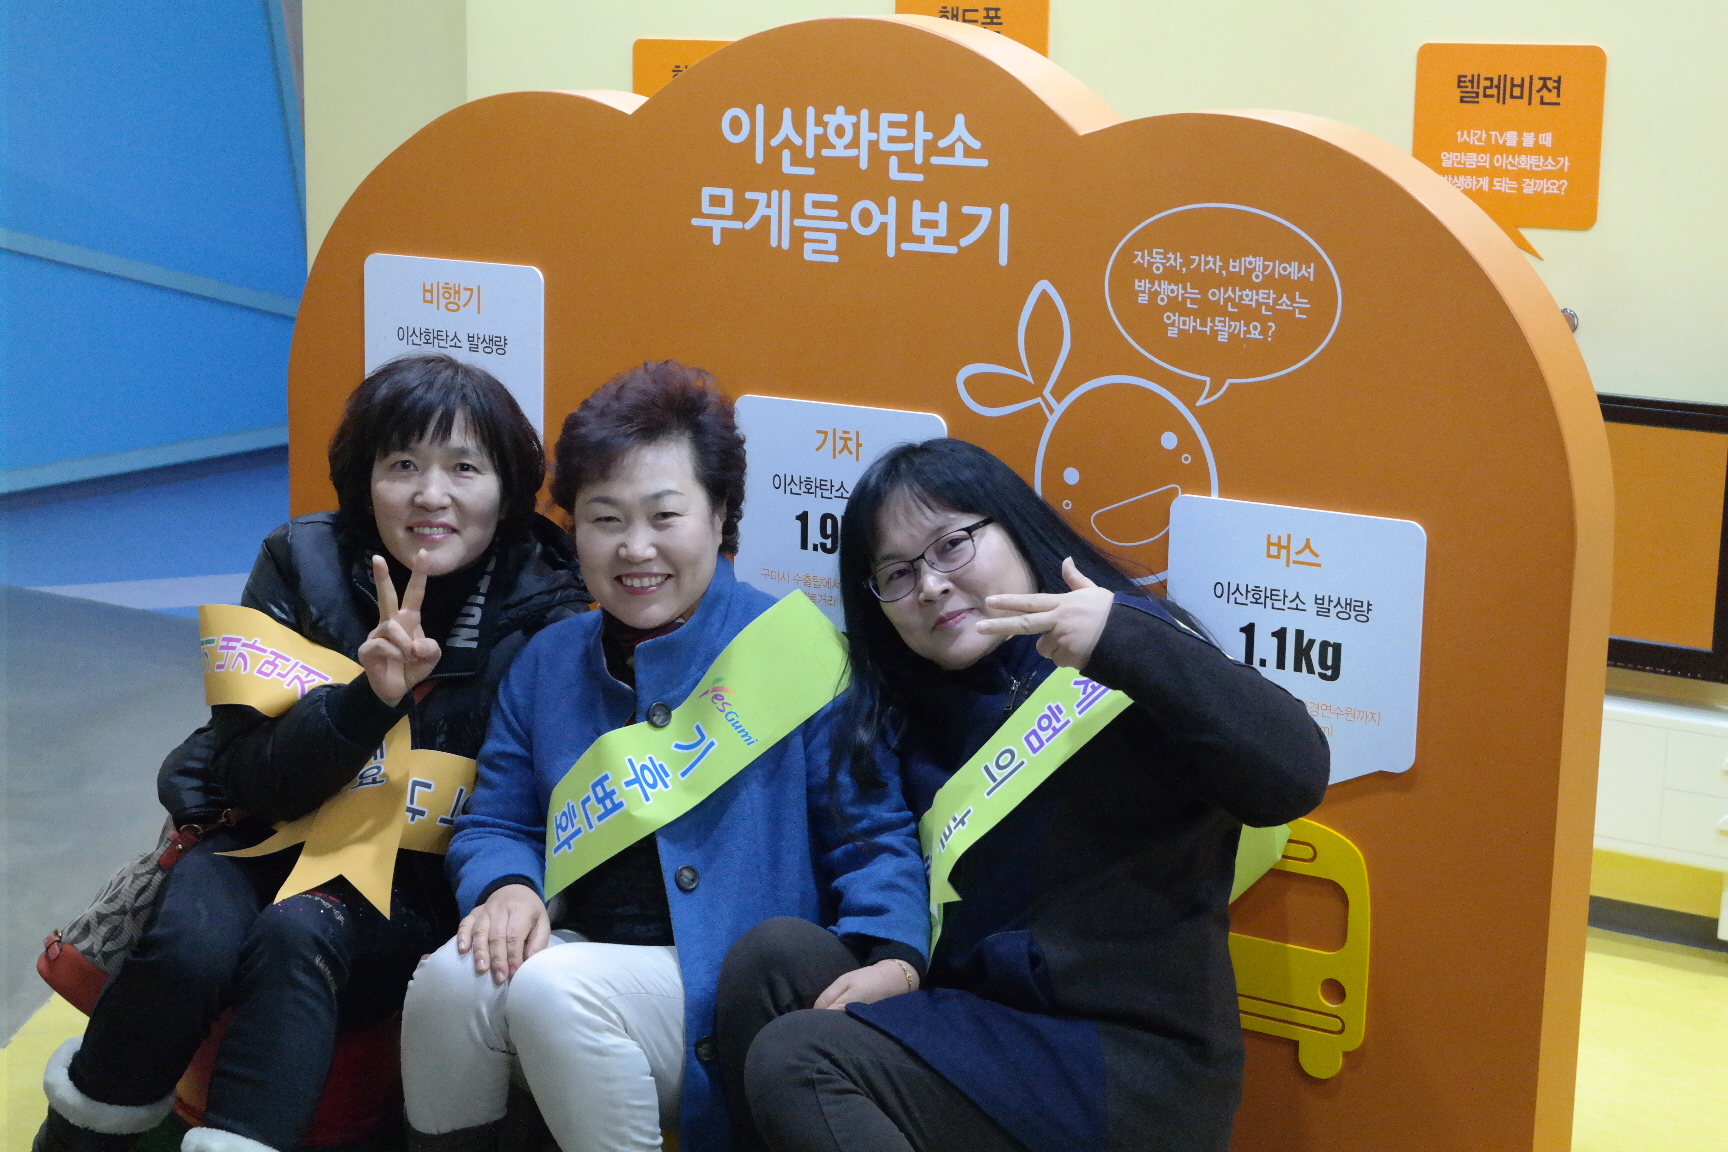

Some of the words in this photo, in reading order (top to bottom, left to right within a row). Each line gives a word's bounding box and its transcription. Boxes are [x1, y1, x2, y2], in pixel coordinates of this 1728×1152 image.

[1456, 73, 1562, 106] 텔레비젼
[721, 103, 989, 182] 이산화탄소
[1455, 129, 1487, 146] 1시간
[1489, 130, 1519, 147] TV를
[1521, 131, 1536, 148] 볼
[1538, 132, 1553, 148] 때
[1440, 151, 1491, 169] 얼만큼의
[1493, 154, 1571, 172] 이산화탄소가
[1492, 177, 1518, 193] 되는
[1521, 178, 1569, 196] 걸까요?
[691, 186, 1009, 267] 무게들어보기
[1133, 248, 1187, 275] 자동차,
[1189, 254, 1227, 277] 기차,
[1229, 255, 1315, 283] 비행기에서
[422, 281, 481, 315] 비행기
[1134, 278, 1201, 309] 발생하는
[1208, 286, 1311, 319] 이산화탄소는
[397, 325, 463, 350] 이산화탄소
[467, 332, 508, 356] 발생량
[815, 427, 863, 462] 기차
[772, 473, 850, 500] 이산화탄소
[795, 510, 844, 555] 1.9
[1265, 533, 1322, 568] 버스
[761, 567, 790, 585] 구미시
[804, 590, 836, 608] 복거리
[1213, 581, 1307, 613] 이산화탄소
[1314, 593, 1373, 624] 발생량
[1239, 621, 1343, 682] 1.1kg
[1305, 701, 1381, 727] 경연수원까지
